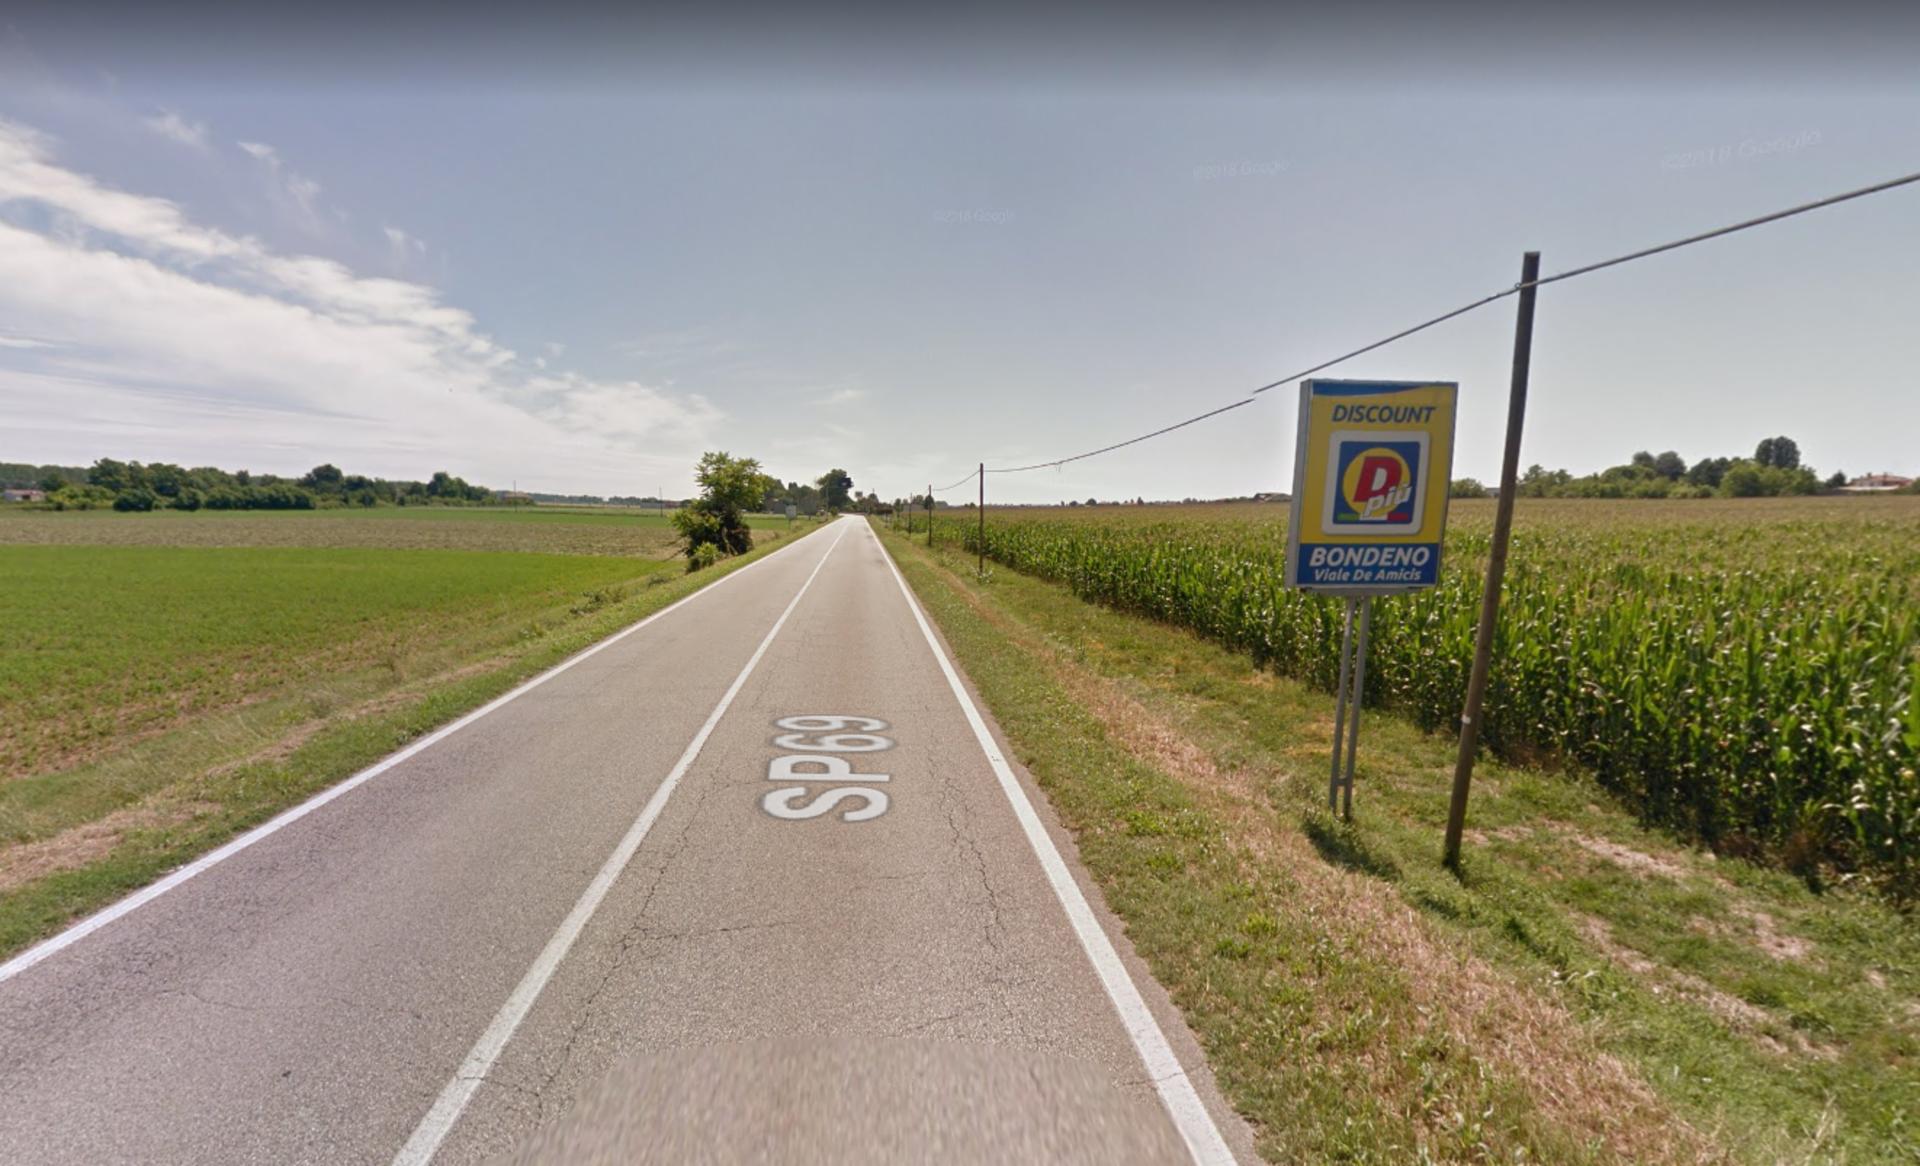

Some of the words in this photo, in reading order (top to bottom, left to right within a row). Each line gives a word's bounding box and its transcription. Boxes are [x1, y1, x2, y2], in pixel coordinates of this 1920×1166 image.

[1332, 404, 1435, 423] DISCOUNT
[1309, 547, 1430, 567] BONDENO
[1314, 568, 1350, 581] Viale
[1353, 569, 1373, 581] De
[1374, 567, 1422, 581] Amicis
